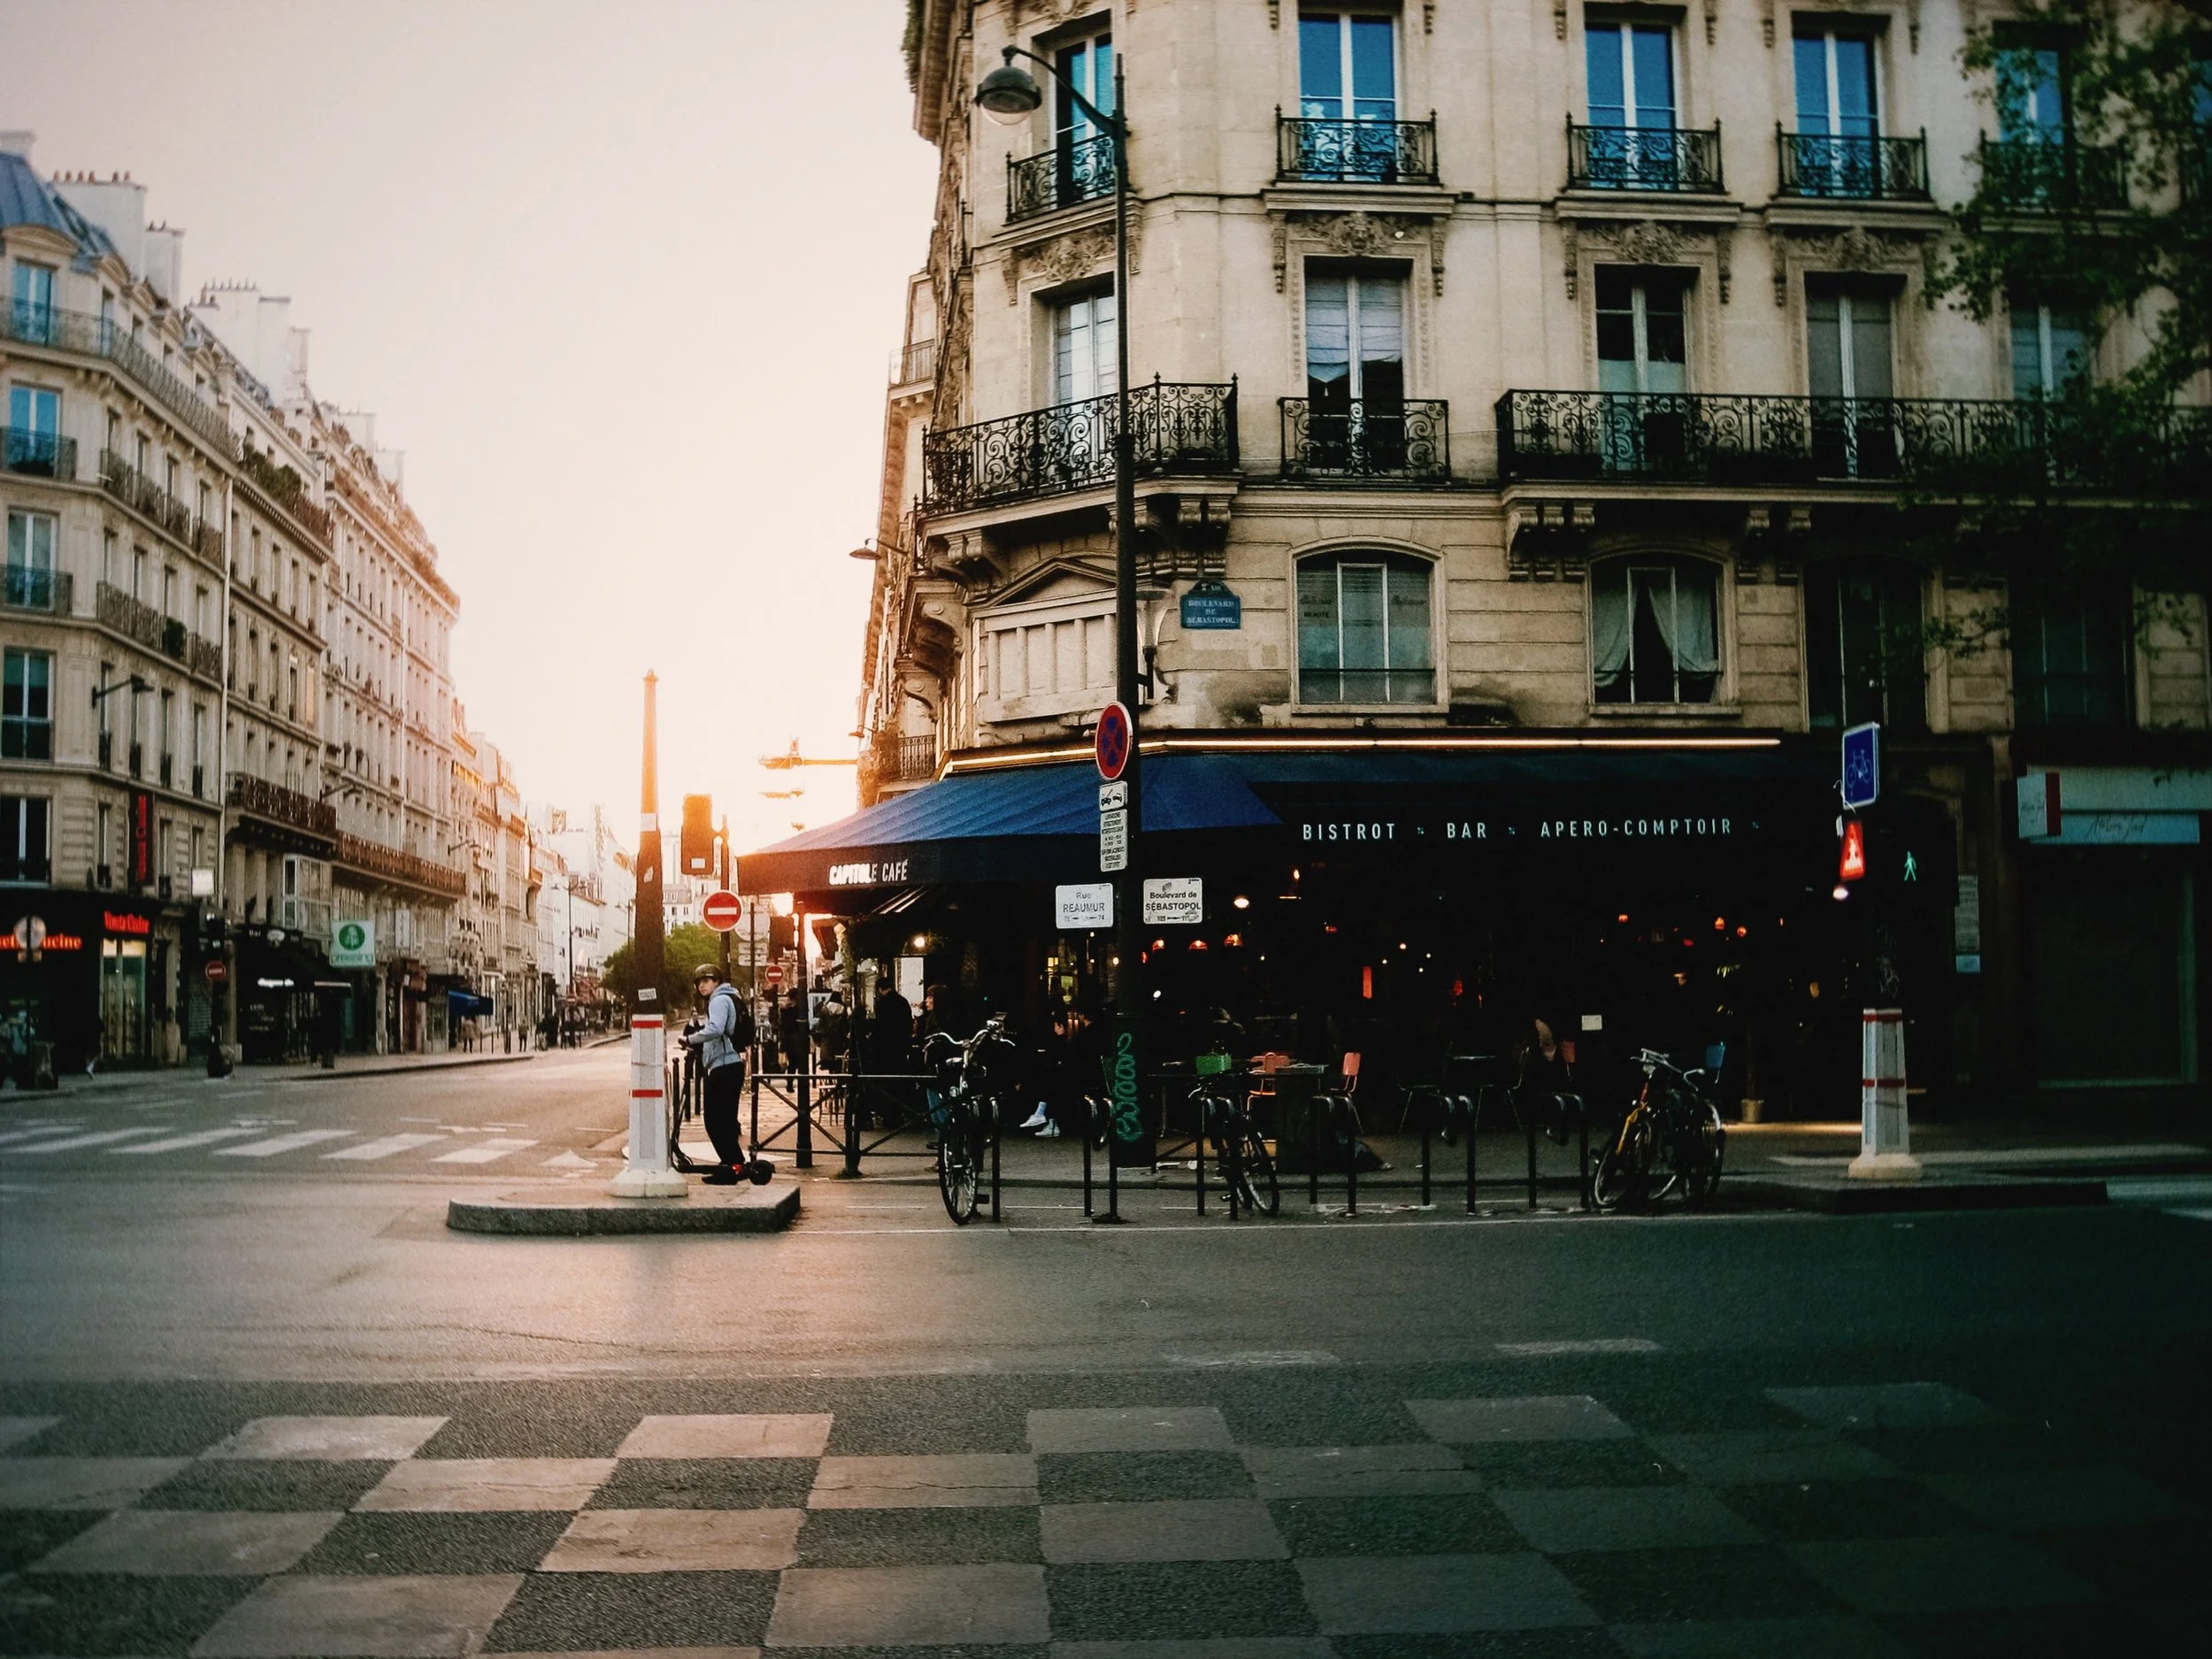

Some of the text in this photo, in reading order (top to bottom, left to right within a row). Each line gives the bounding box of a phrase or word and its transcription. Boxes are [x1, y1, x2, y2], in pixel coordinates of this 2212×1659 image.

[1302, 818, 1732, 841] BISTROT BAR APERO-COMPTOIR
[829, 859, 909, 885] CAPITOLE CAFÉ
[1063, 902, 1105, 913] REAUMUR
[1145, 901, 1202, 911] SÉBASTOPOL
